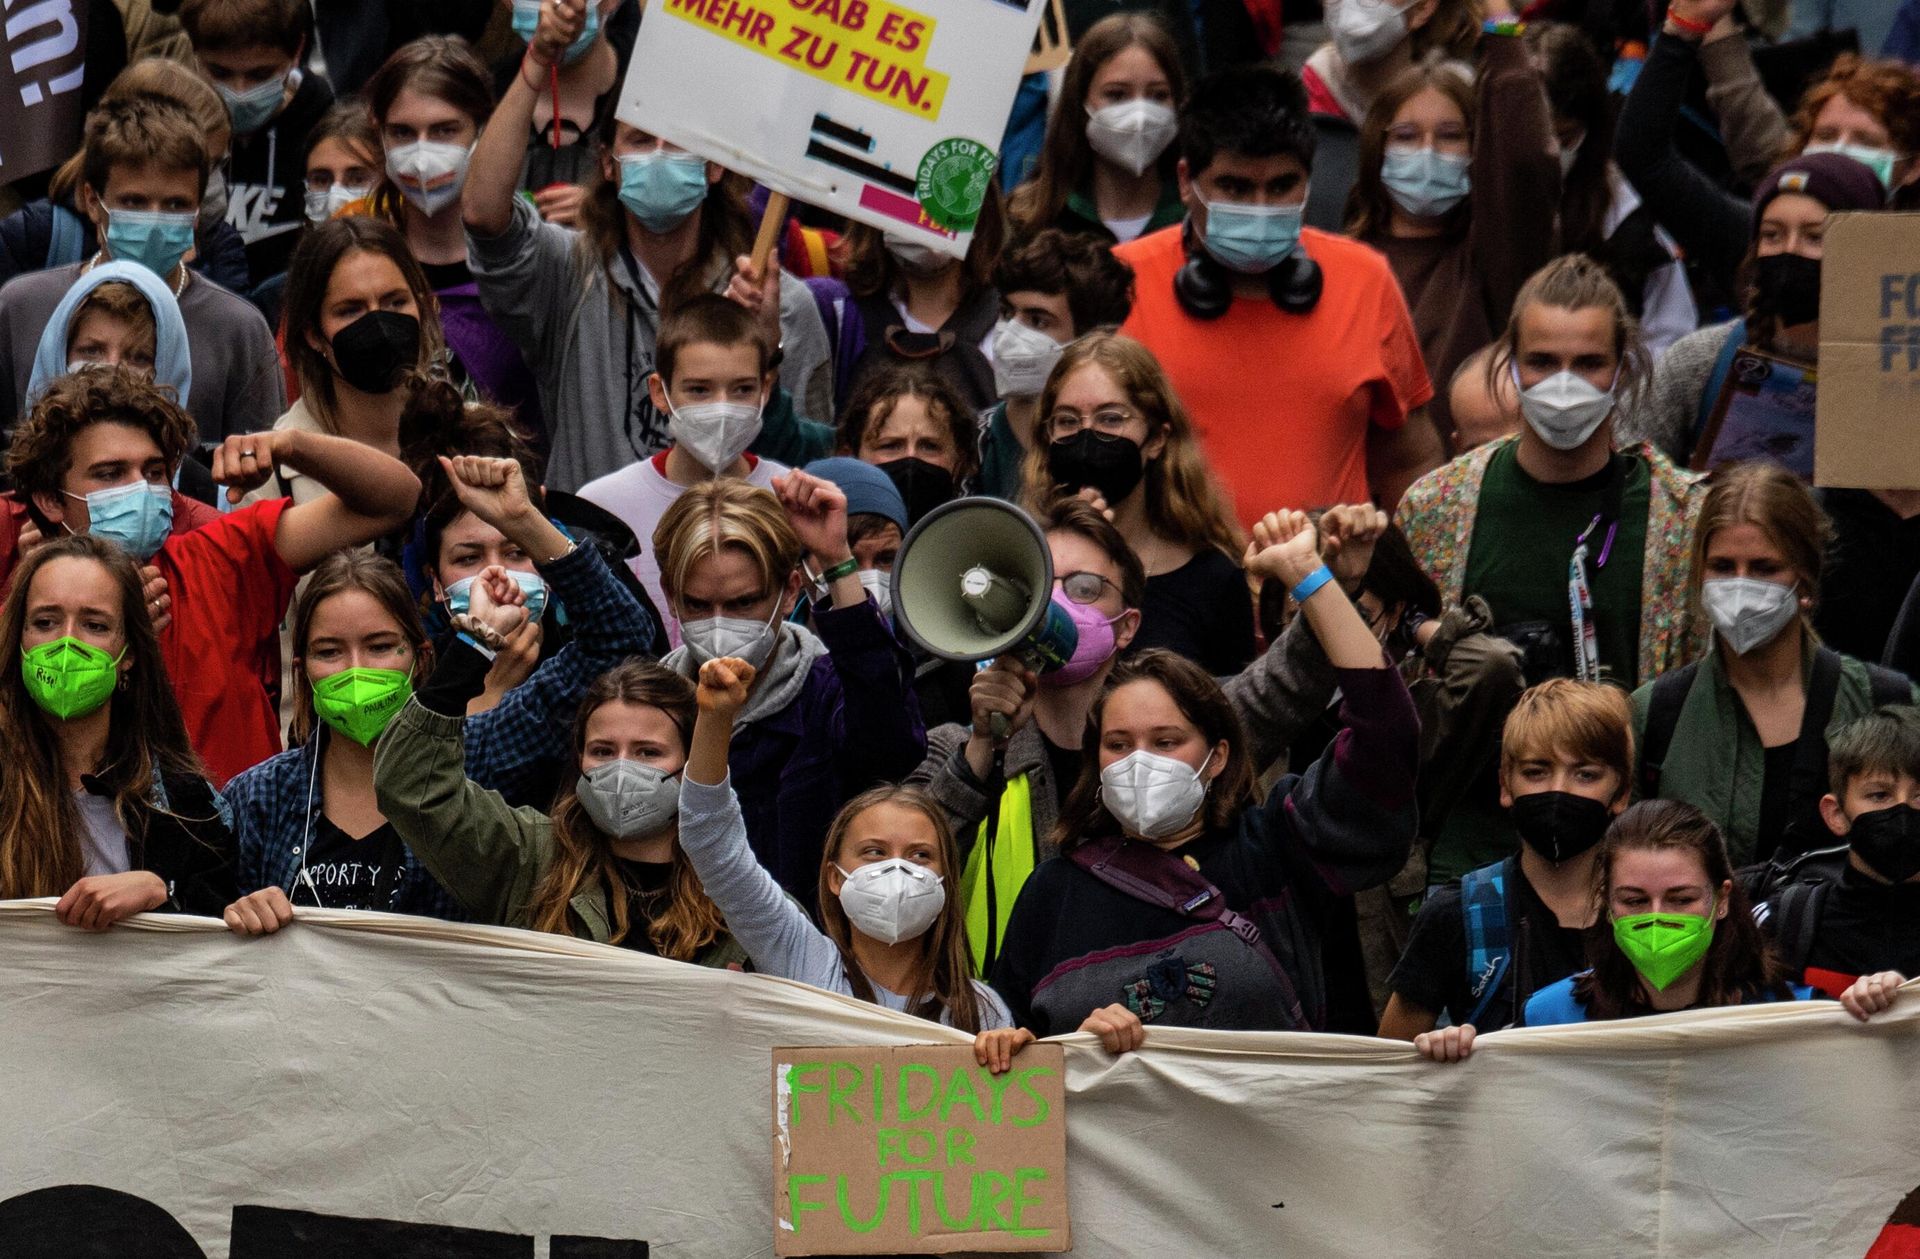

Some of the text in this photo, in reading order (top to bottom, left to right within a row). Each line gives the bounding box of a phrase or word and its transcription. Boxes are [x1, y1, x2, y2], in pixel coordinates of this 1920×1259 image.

[875, 12, 926, 52] ES
[779, 25, 838, 70] ZU
[845, 50, 931, 111] TUN.
[918, 144, 950, 200] FRIDAYS
[951, 142, 977, 157] FOR
[786, 1061, 1056, 1127] FRIDAYS
[877, 1127, 977, 1167] FOR
[788, 1166, 1048, 1237] FUTURE
